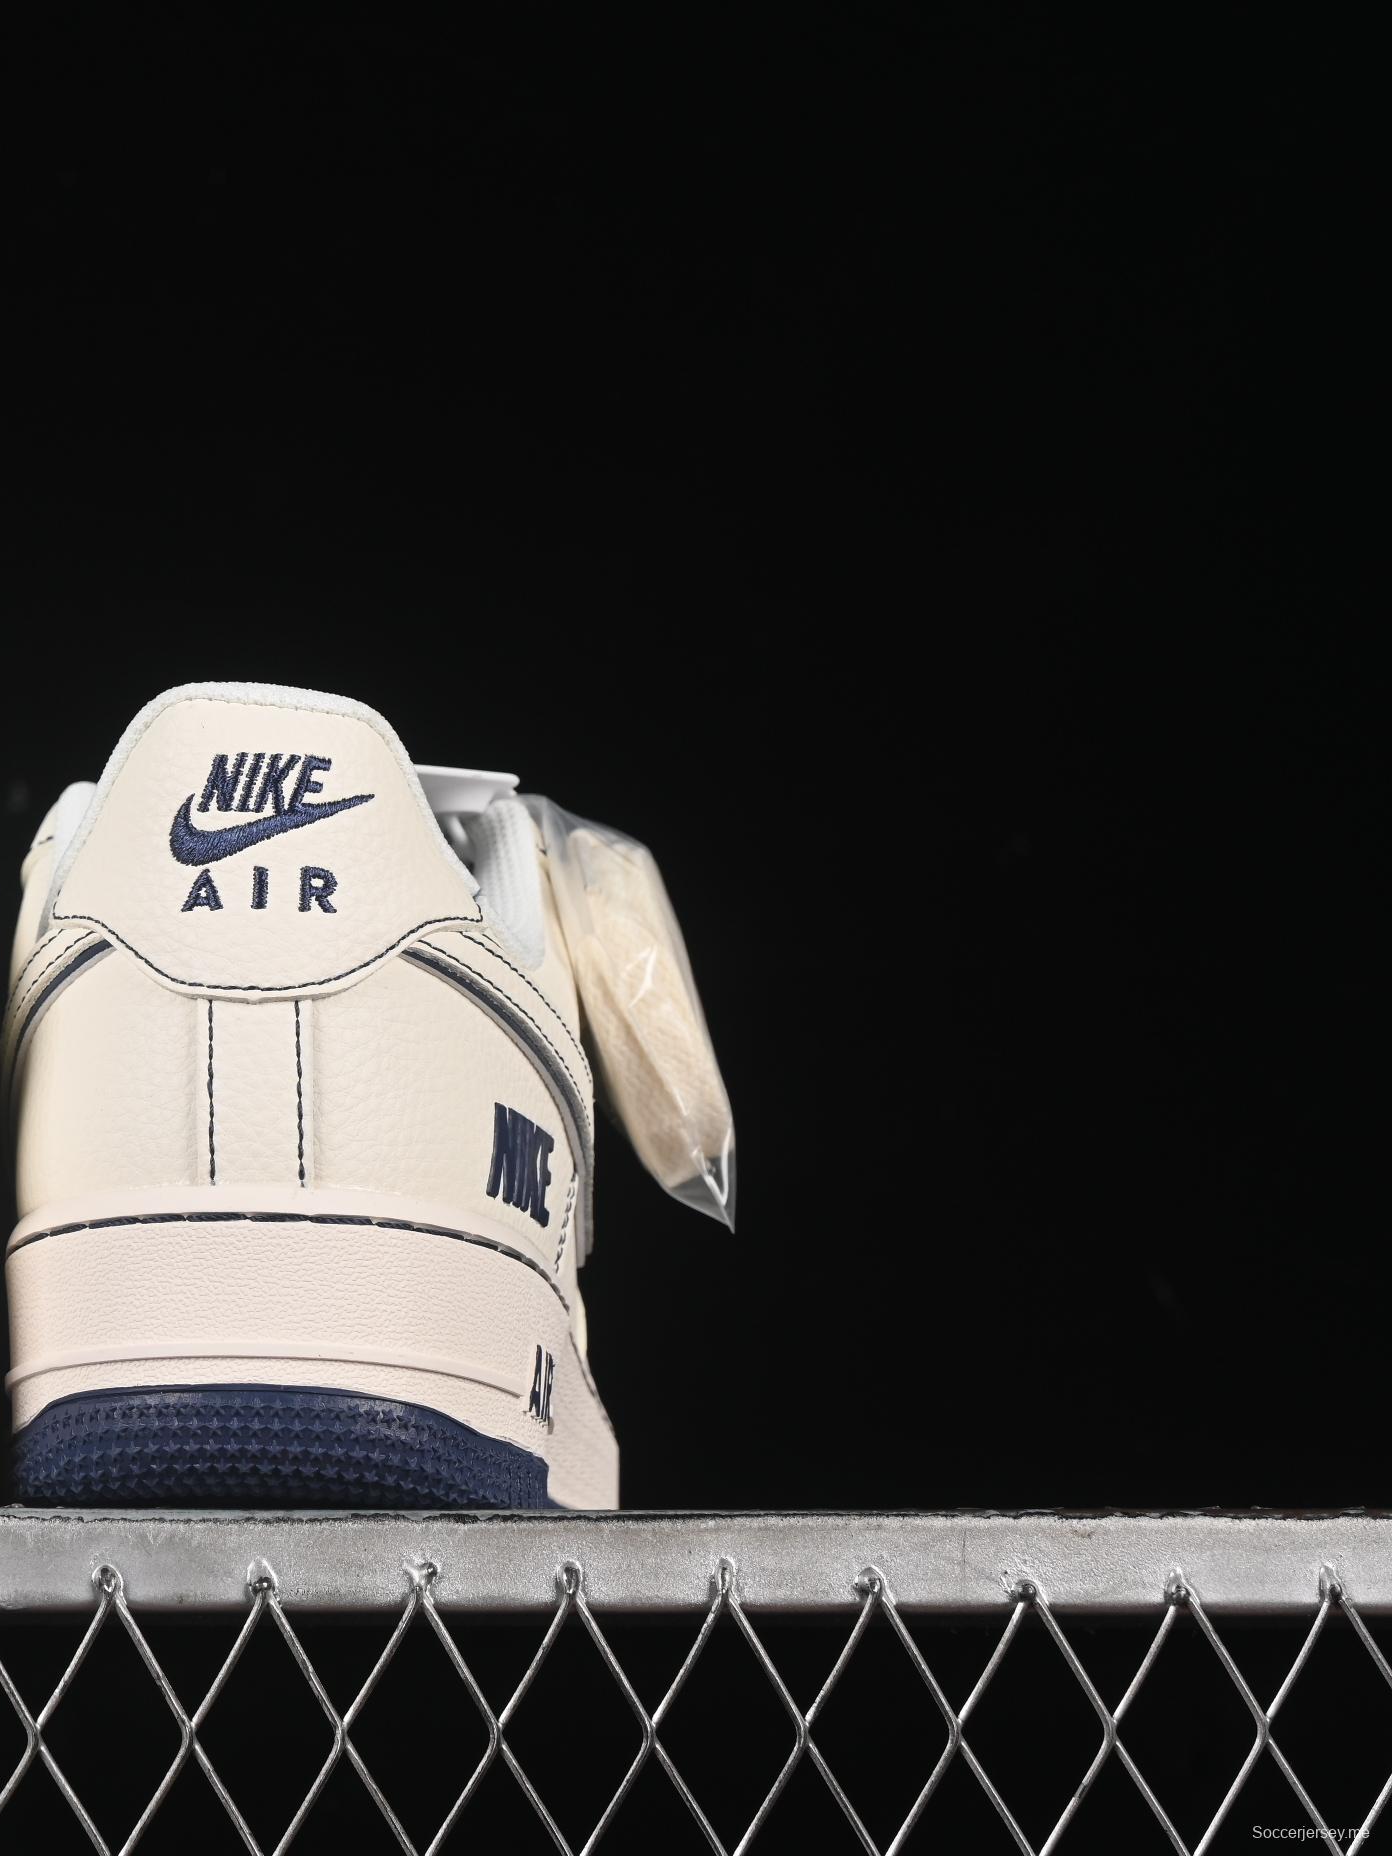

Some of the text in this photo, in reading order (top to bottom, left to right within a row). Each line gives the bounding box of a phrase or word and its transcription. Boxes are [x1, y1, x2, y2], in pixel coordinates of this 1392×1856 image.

[196, 752, 332, 815] NIKE
[180, 866, 338, 913] AIR
[485, 1102, 555, 1227] NIKE
